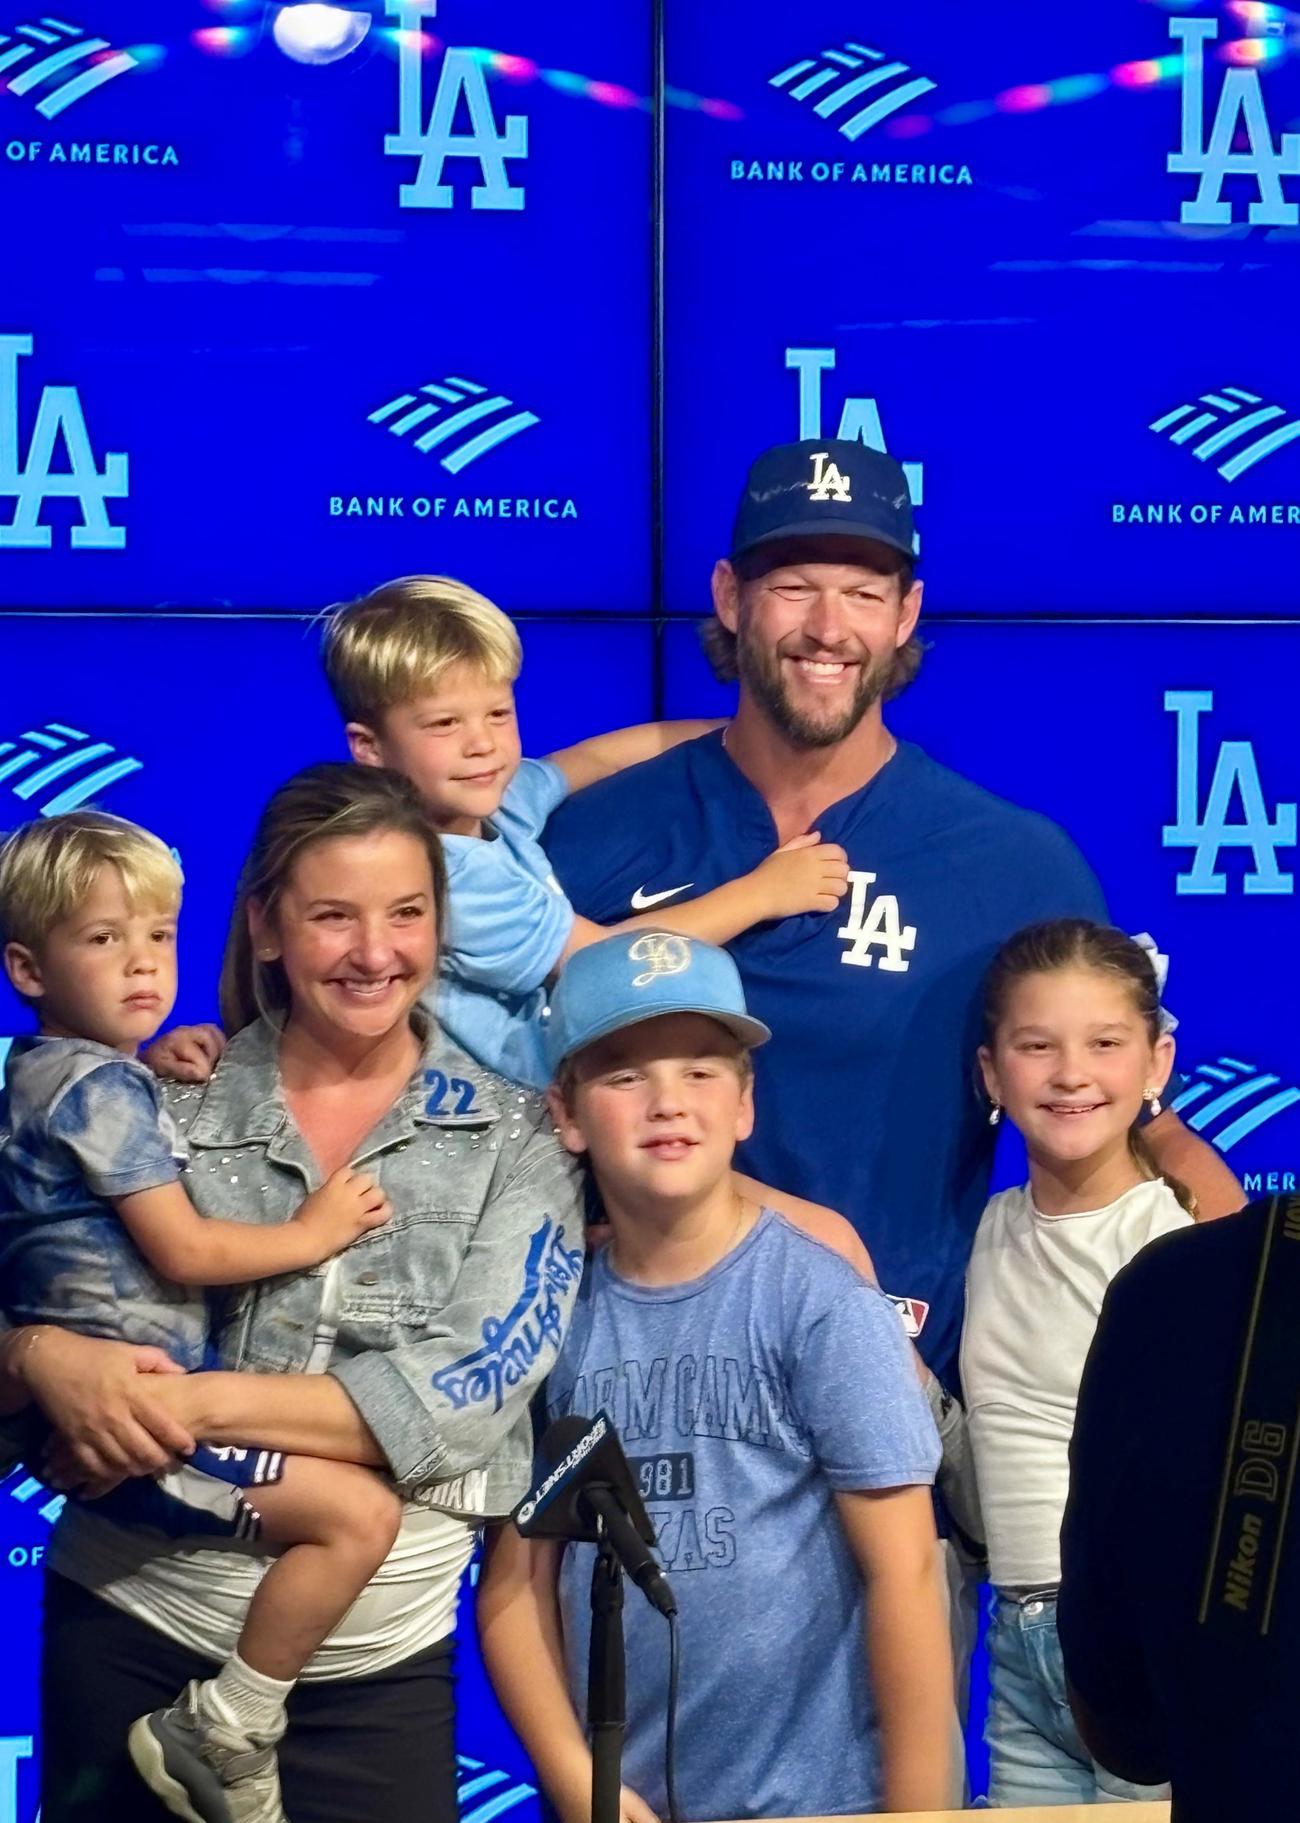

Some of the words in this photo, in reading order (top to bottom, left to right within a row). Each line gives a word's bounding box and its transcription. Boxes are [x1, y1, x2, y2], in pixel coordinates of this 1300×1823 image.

[384, 0, 529, 210] LA
[1167, 16, 1300, 227] LA
[5, 140, 42, 161] OF
[49, 142, 179, 165] AMERICA
[731, 160, 803, 181] BANK
[810, 162, 844, 181] OF
[851, 163, 973, 185] AMERICA
[0, 334, 129, 549] LA
[806, 452, 852, 503] LA
[329, 496, 404, 517] BANK
[412, 497, 447, 517] OF
[453, 498, 578, 519] AMERICA
[1112, 504, 1182, 524] BANK
[1190, 504, 1223, 524] OF
[1229, 505, 1300, 524] AMER
[1162, 690, 1298, 895] LA
[837, 870, 917, 972] LA
[423, 1069, 482, 1116] 22
[1243, 1172, 1296, 1192] MER
[637, 1457, 693, 1498] 981
[1233, 1419, 1287, 1502] D6
[8, 1546, 45, 1567] OF
[1222, 1512, 1263, 1611] Nikon
